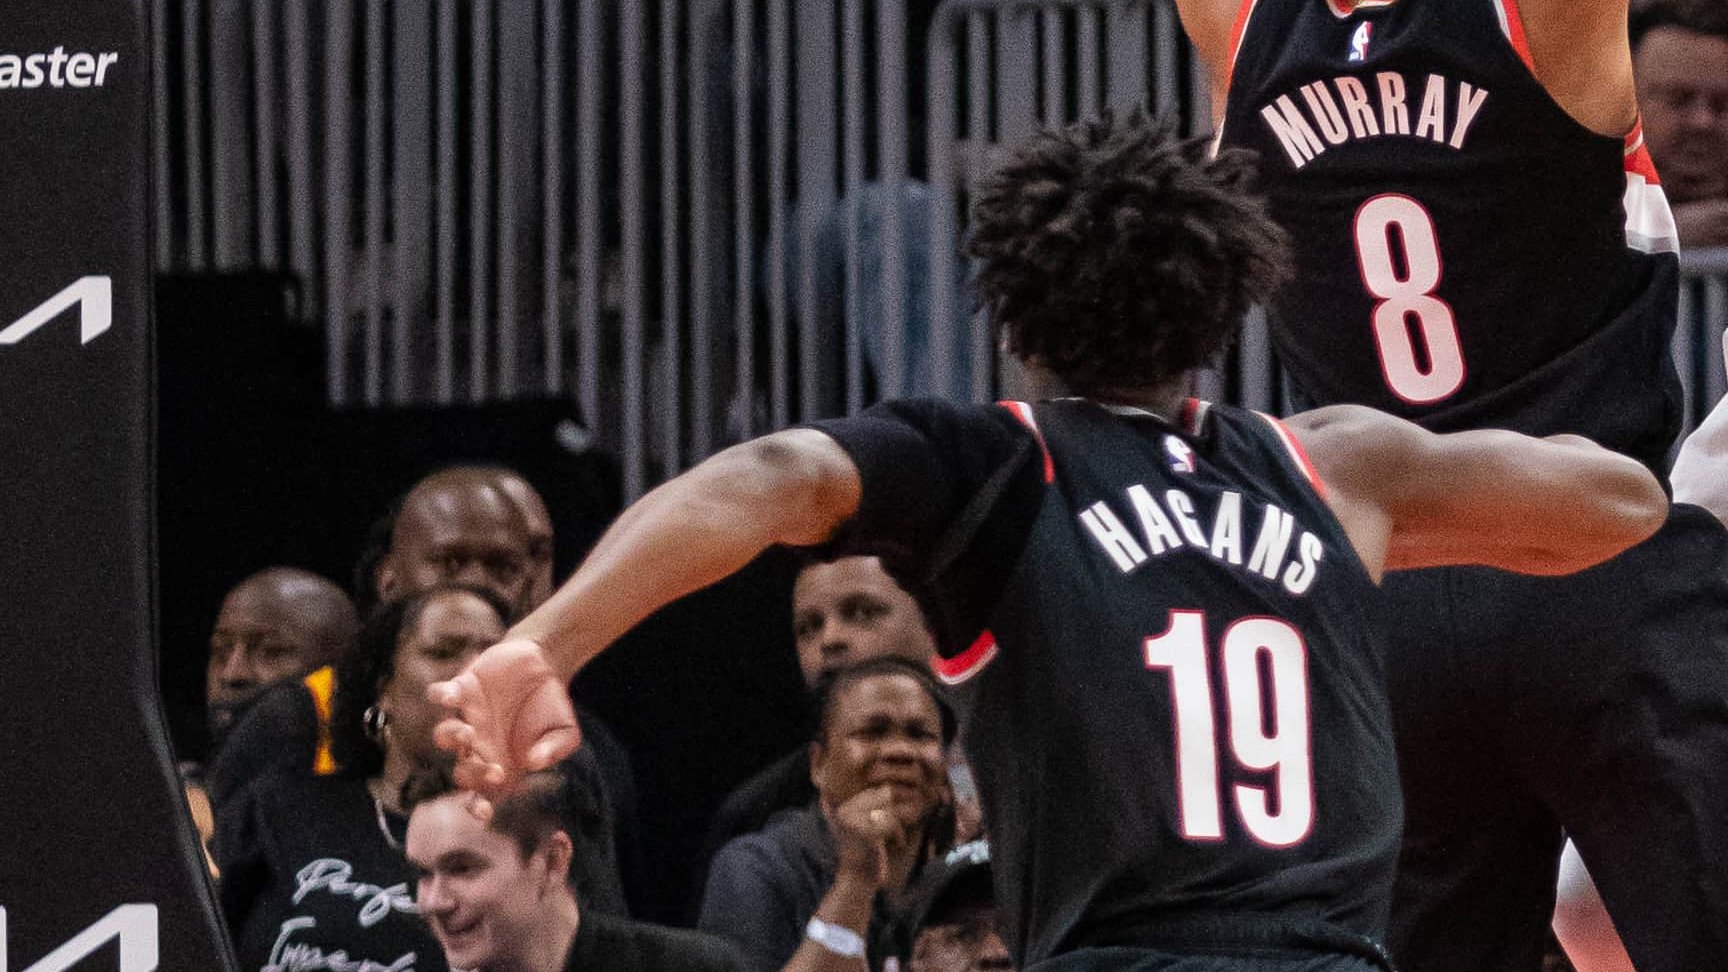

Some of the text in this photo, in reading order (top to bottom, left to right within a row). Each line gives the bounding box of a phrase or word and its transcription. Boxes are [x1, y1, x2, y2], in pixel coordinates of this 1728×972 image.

[0, 45, 119, 88] aster
[1260, 71, 1488, 168] MURRAY
[1353, 193, 1467, 404] 8
[1080, 484, 1323, 594] HAGANS
[1143, 609, 1315, 848] 19
